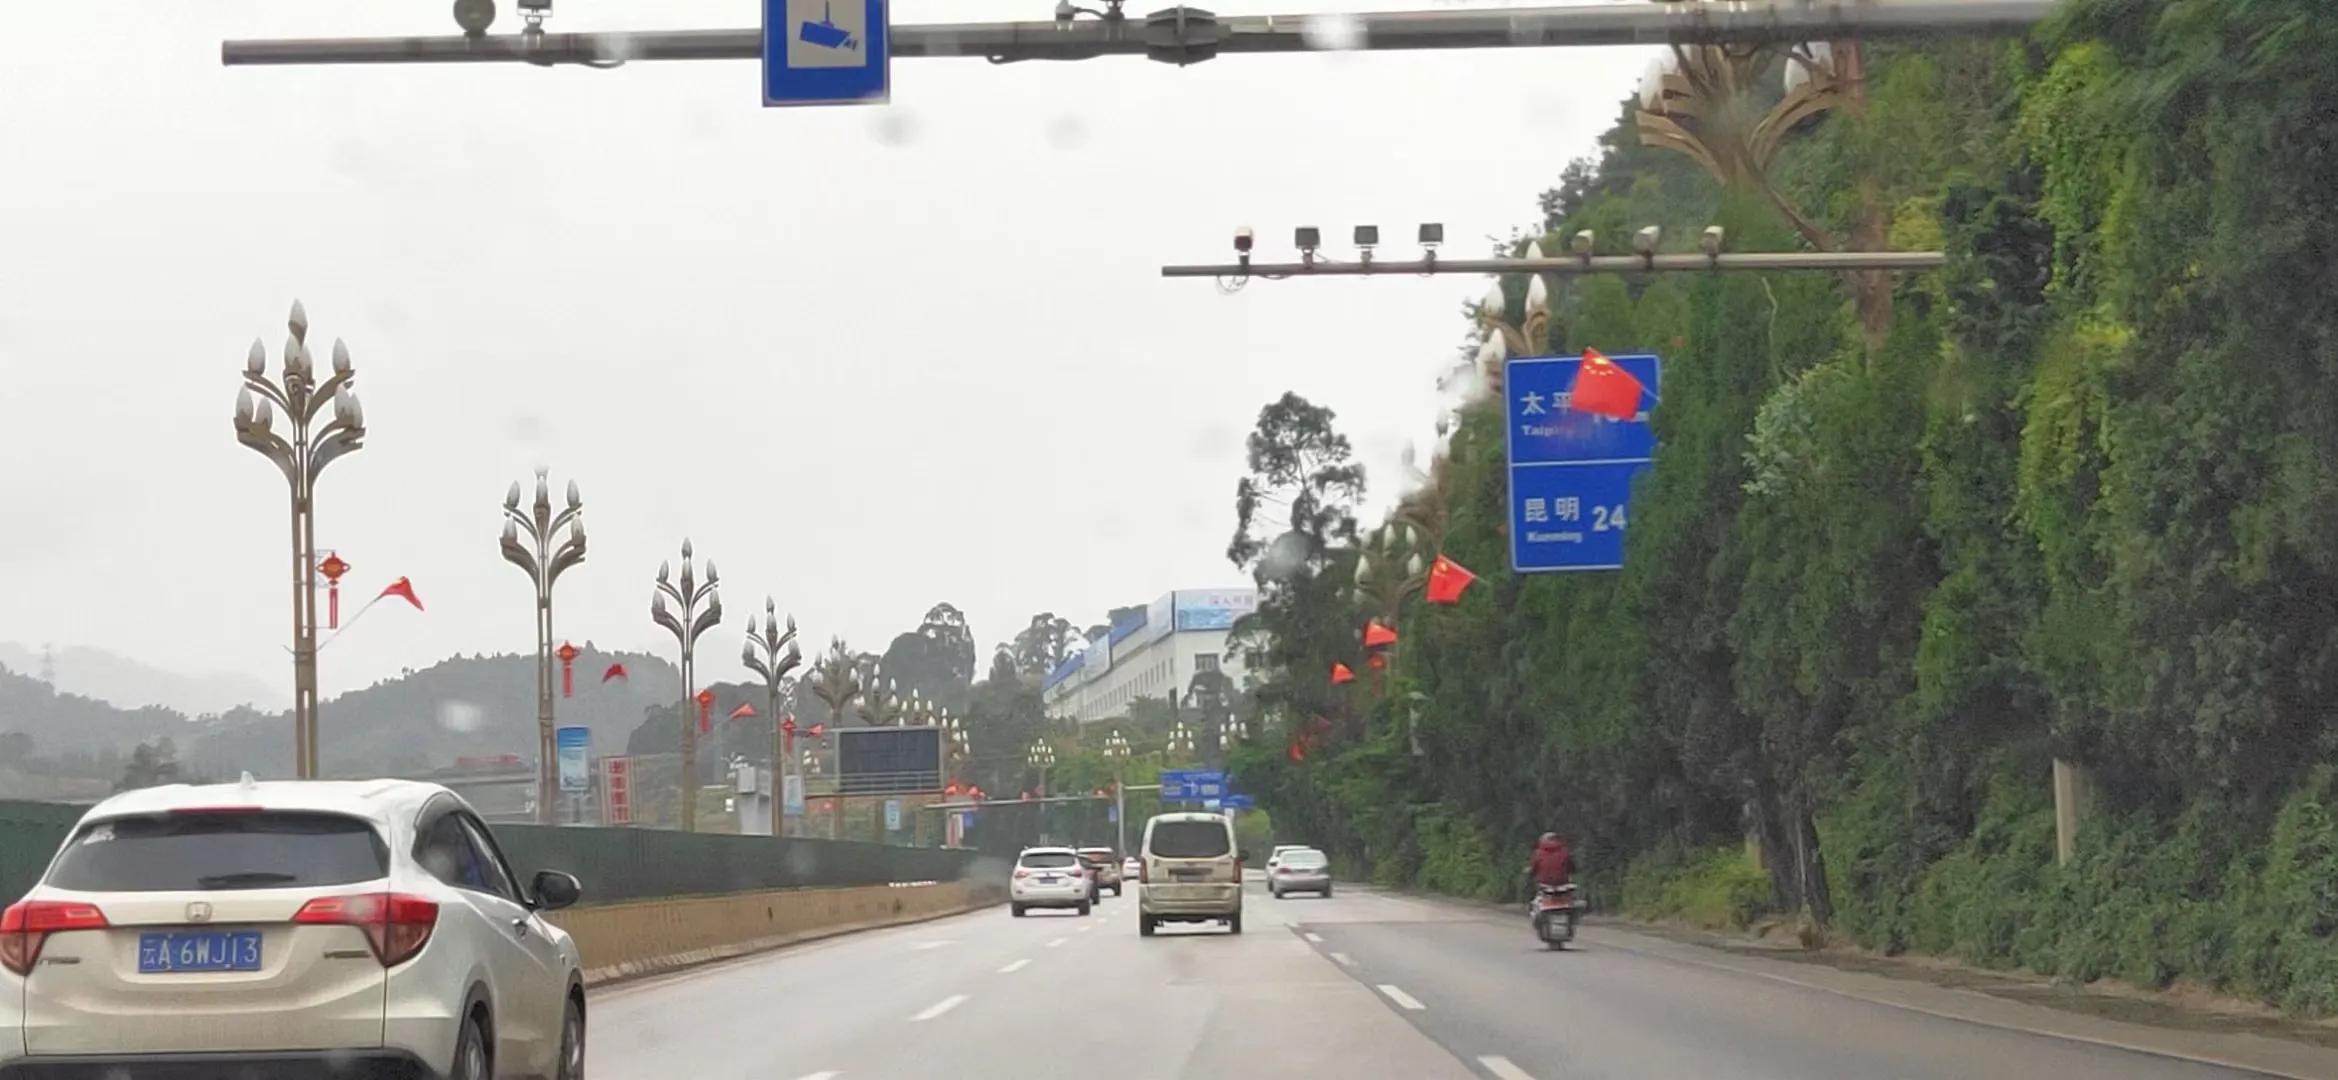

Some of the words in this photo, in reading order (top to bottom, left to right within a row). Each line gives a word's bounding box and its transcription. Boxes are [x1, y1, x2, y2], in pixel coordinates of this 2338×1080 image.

[1520, 391, 1573, 415] 太平
[1525, 496, 1580, 522] 昆明
[1592, 504, 1627, 532] 24
